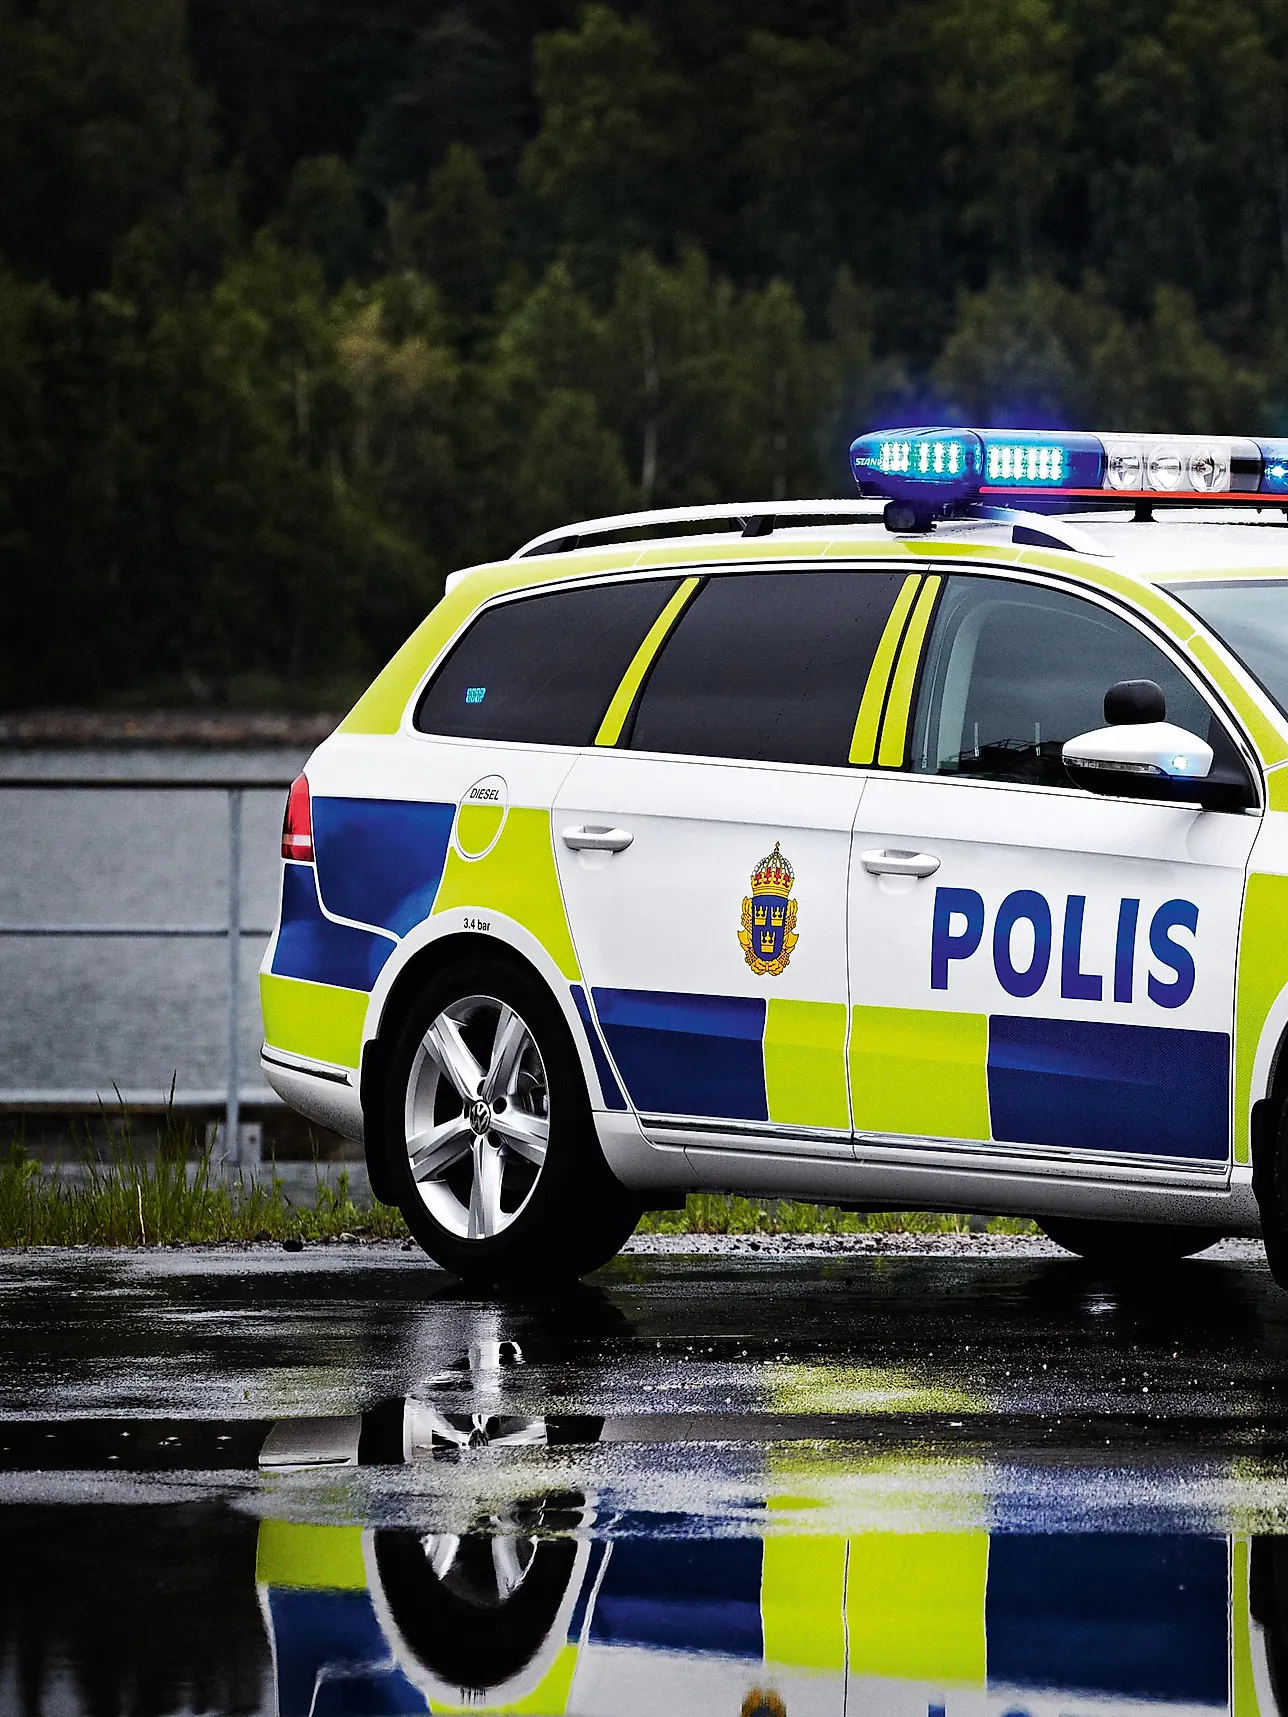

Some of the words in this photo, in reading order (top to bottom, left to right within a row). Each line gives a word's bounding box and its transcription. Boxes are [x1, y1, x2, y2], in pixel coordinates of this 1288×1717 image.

[470, 788, 499, 800] DIESEL
[463, 917, 475, 930] 3.4
[477, 919, 490, 931] bar
[930, 887, 1200, 1009] POLIS
